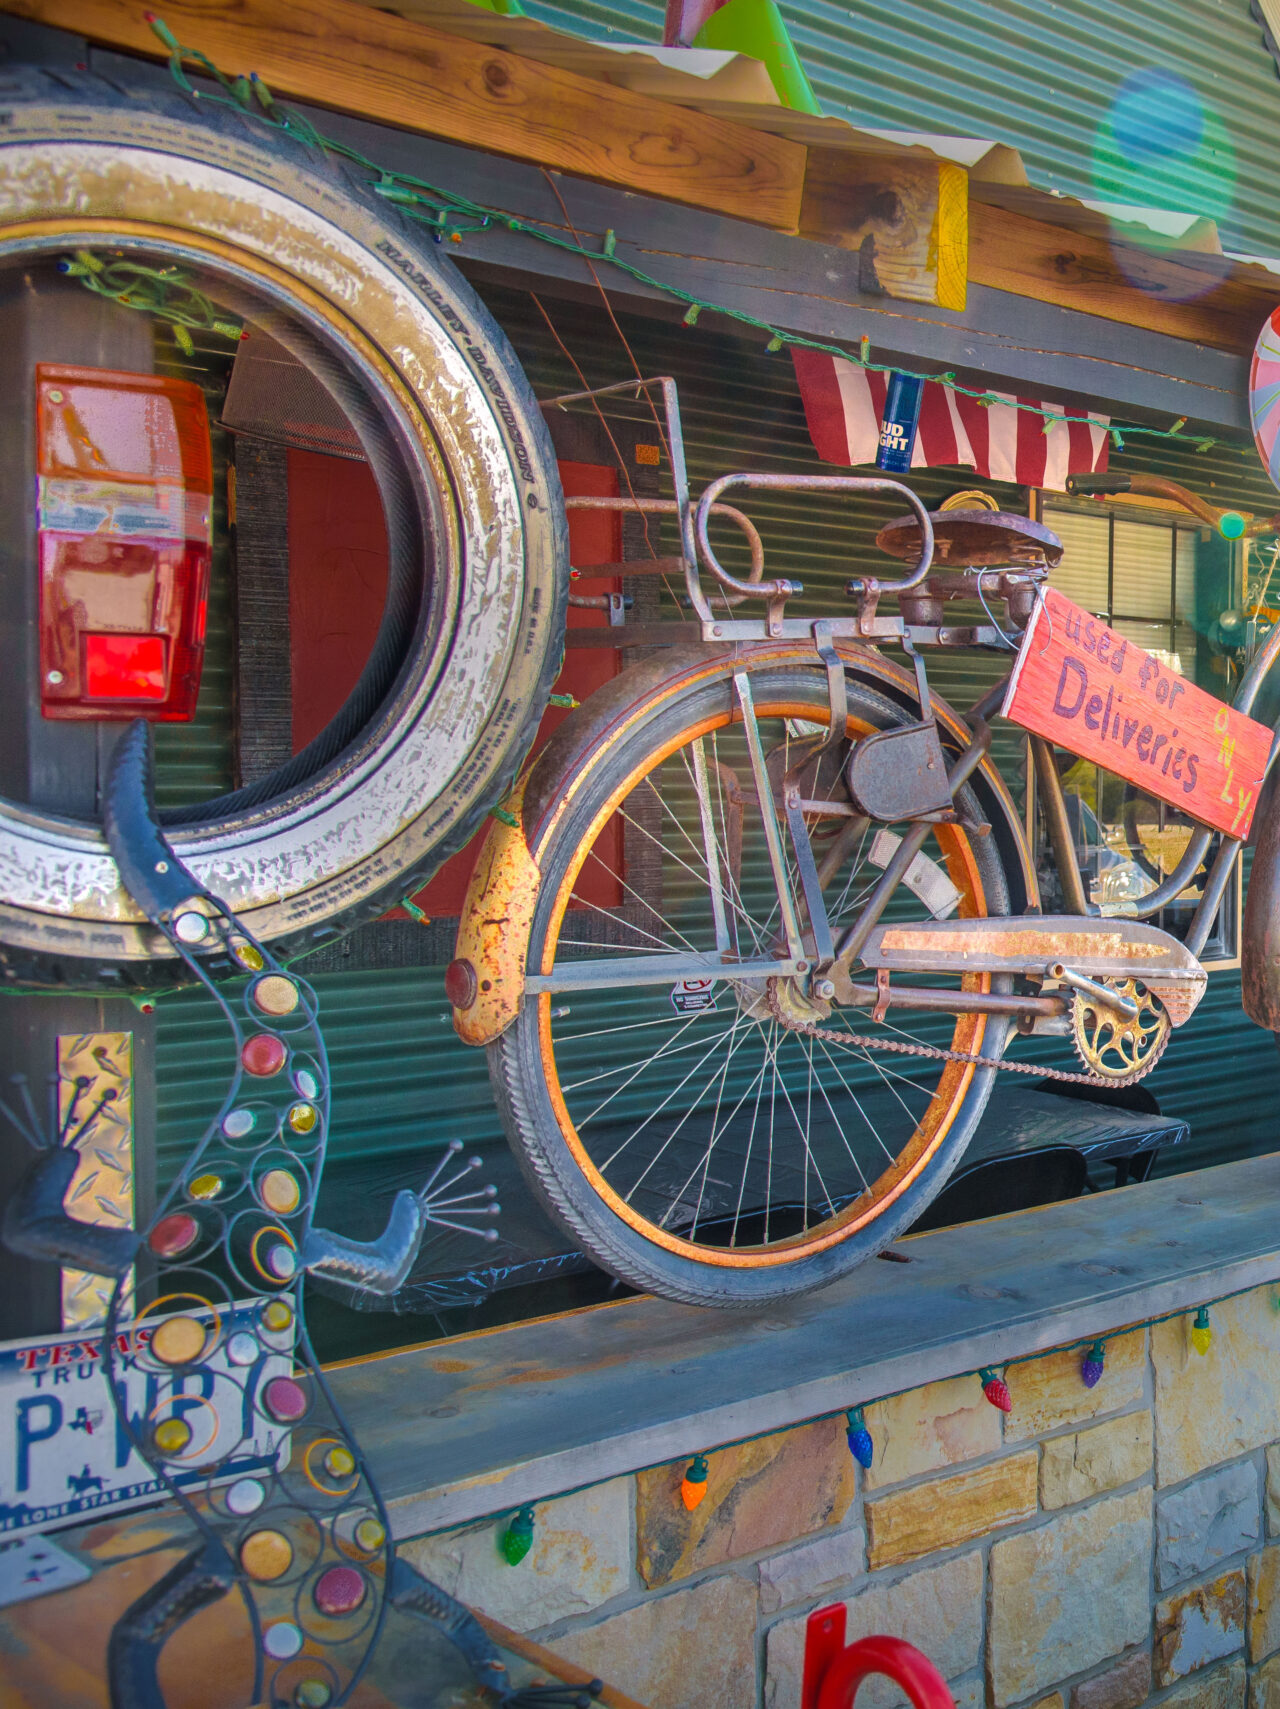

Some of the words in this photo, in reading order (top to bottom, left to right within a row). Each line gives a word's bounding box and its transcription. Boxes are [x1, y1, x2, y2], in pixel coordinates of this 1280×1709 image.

[1052, 655, 1200, 794] Deliveries
[21, 1503, 70, 1525] LONE
[80, 1488, 122, 1510] STAR
